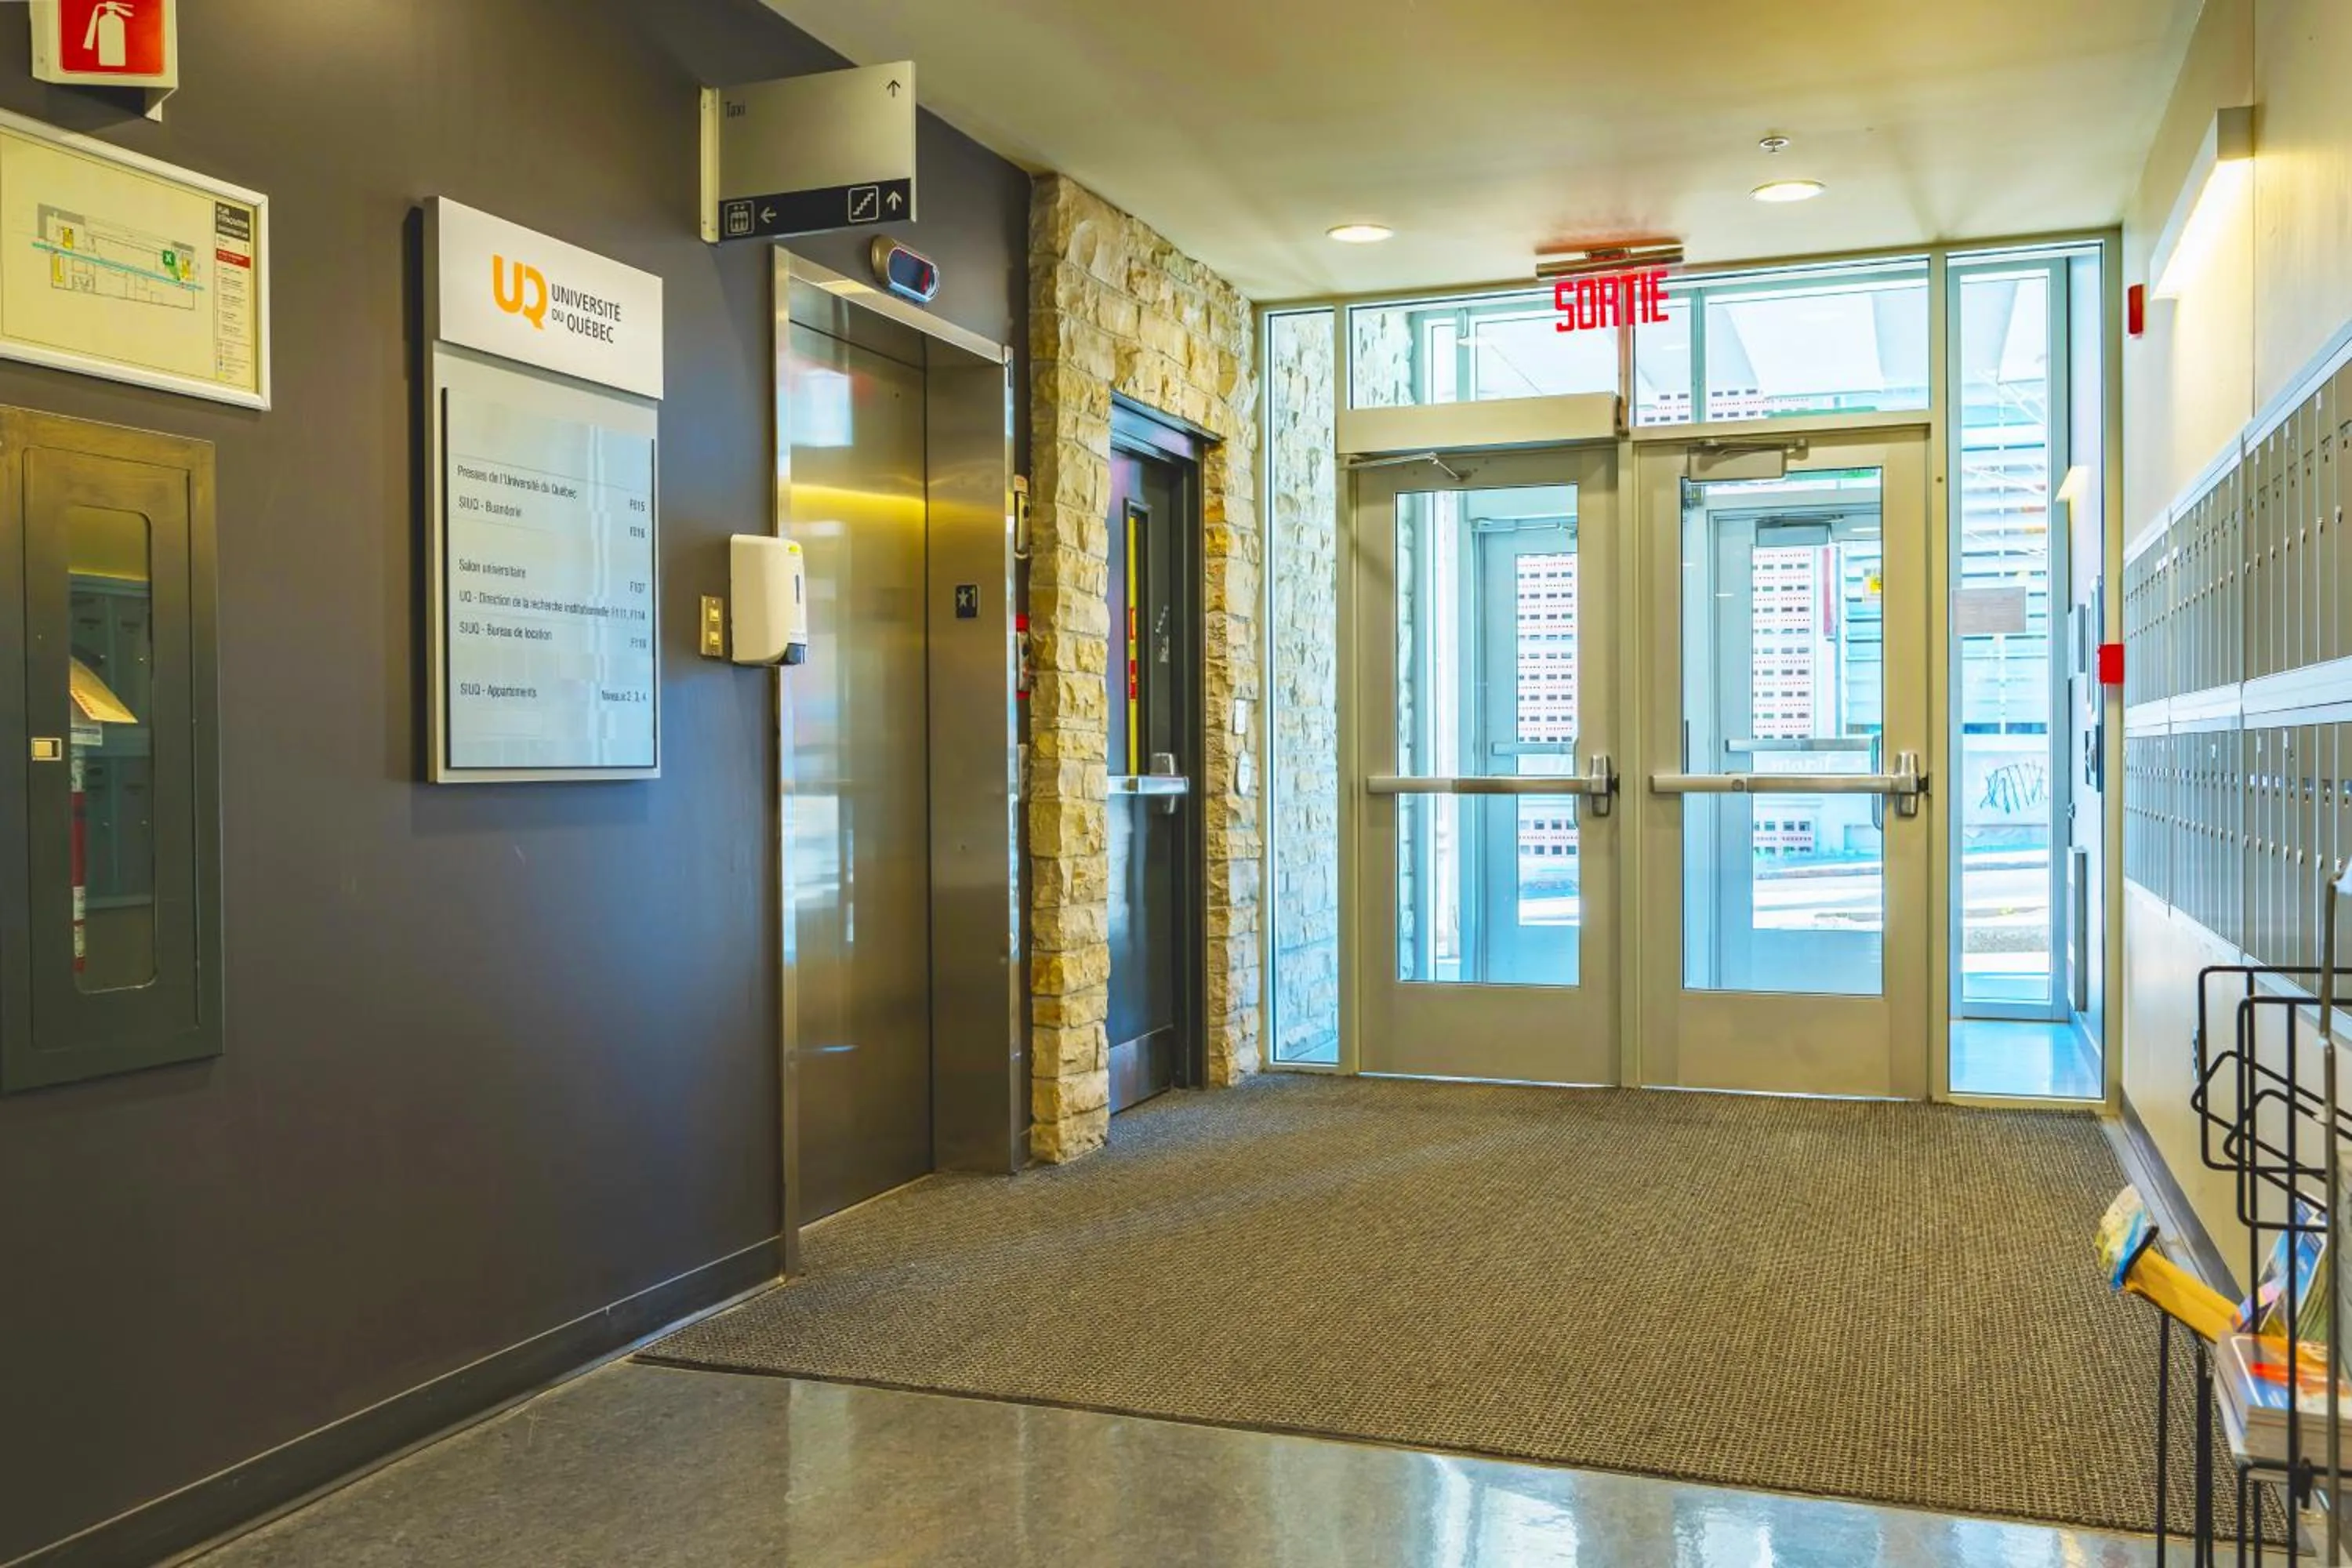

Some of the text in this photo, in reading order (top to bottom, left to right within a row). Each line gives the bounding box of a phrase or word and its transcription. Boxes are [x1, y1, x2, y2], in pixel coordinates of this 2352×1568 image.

[725, 101, 746, 118] Taxi
[492, 253, 548, 330] UQ
[551, 284, 622, 321] UNIVERSITÉ
[1555, 270, 1669, 332] SORTIE
[551, 308, 615, 343] DU QUÉBEC
[457, 465, 488, 483] Presses
[488, 472, 499, 484] de
[541, 483, 550, 494] du
[459, 558, 481, 573] Salon
[514, 626, 523, 639] de
[524, 626, 553, 641] location
